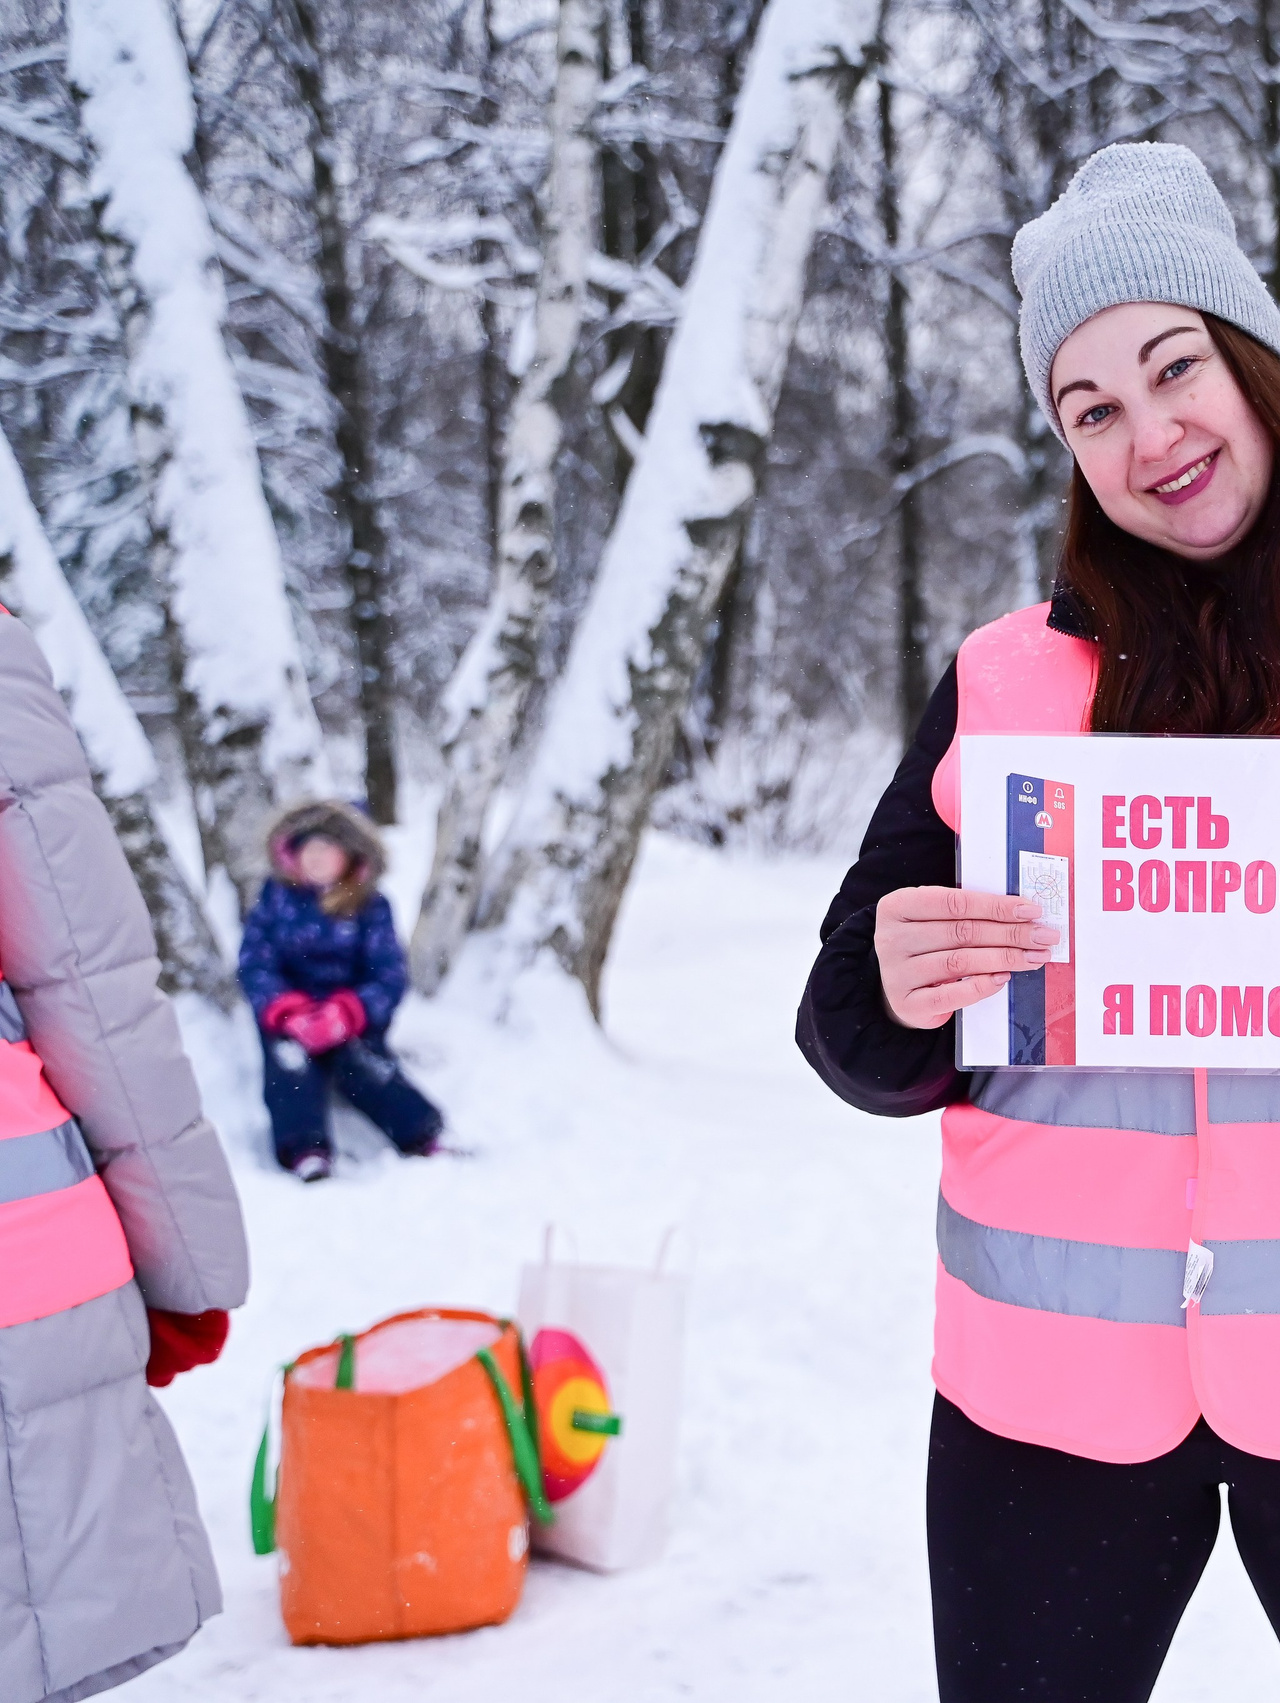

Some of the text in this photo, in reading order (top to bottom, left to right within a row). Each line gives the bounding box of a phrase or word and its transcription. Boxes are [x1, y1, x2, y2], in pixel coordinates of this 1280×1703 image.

[1053, 800, 1066, 810] SOS
[1102, 795, 1229, 849] ЕСТЬ
[1103, 983, 1133, 1035] Я
